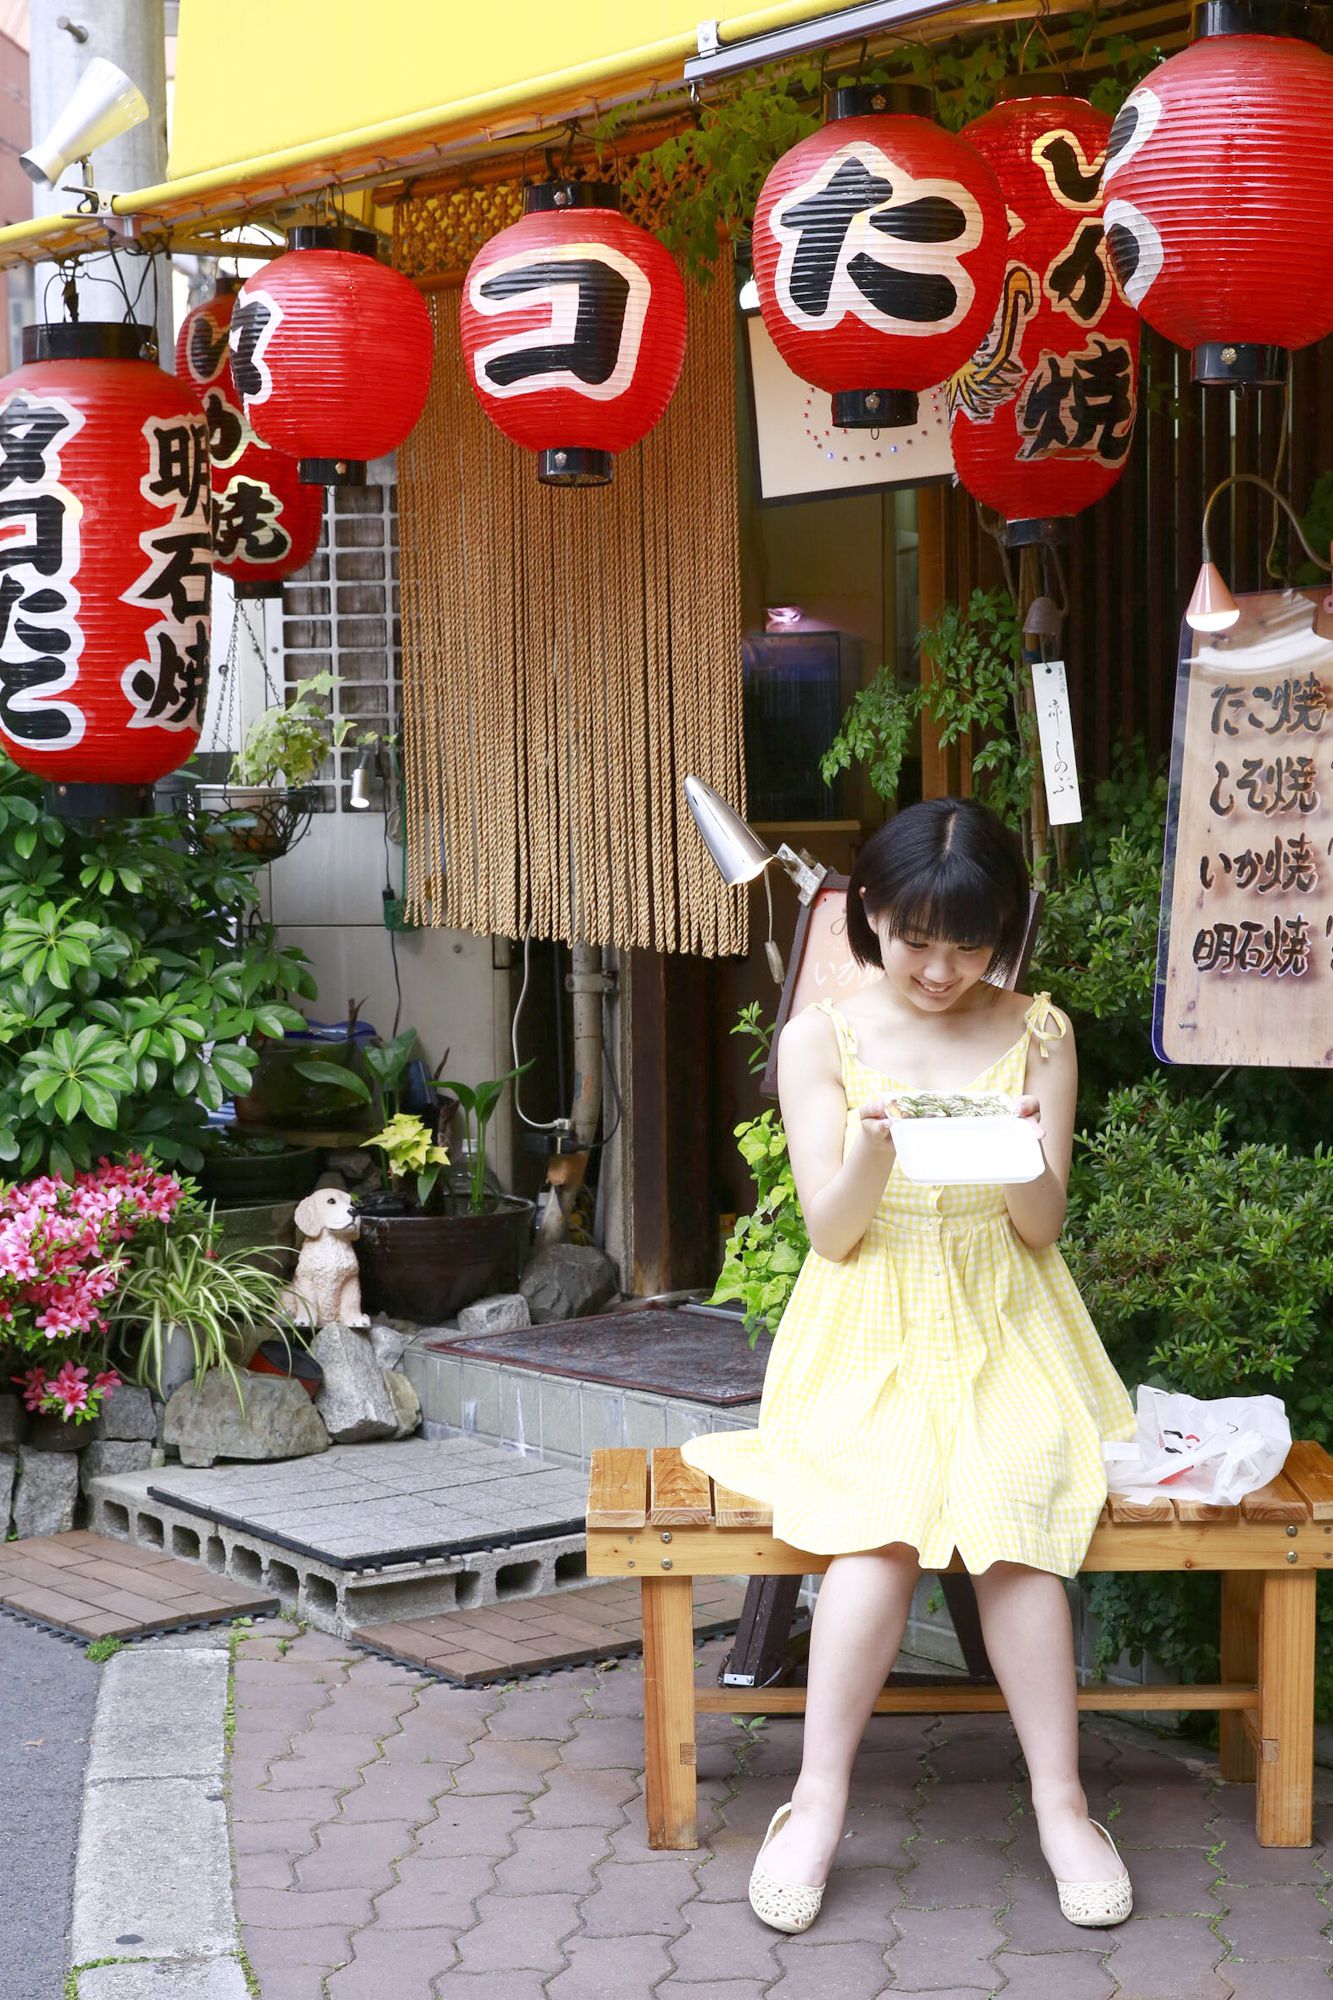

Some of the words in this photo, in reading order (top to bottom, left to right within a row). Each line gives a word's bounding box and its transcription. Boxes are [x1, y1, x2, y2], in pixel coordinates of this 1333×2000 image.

[778, 154, 968, 322] た
[477, 257, 632, 388] コ
[1210, 671, 1328, 737] たこ焼
[1209, 755, 1319, 816] しそ焼
[1200, 832, 1319, 893] いか焼
[1192, 911, 1312, 976] 明石焼
